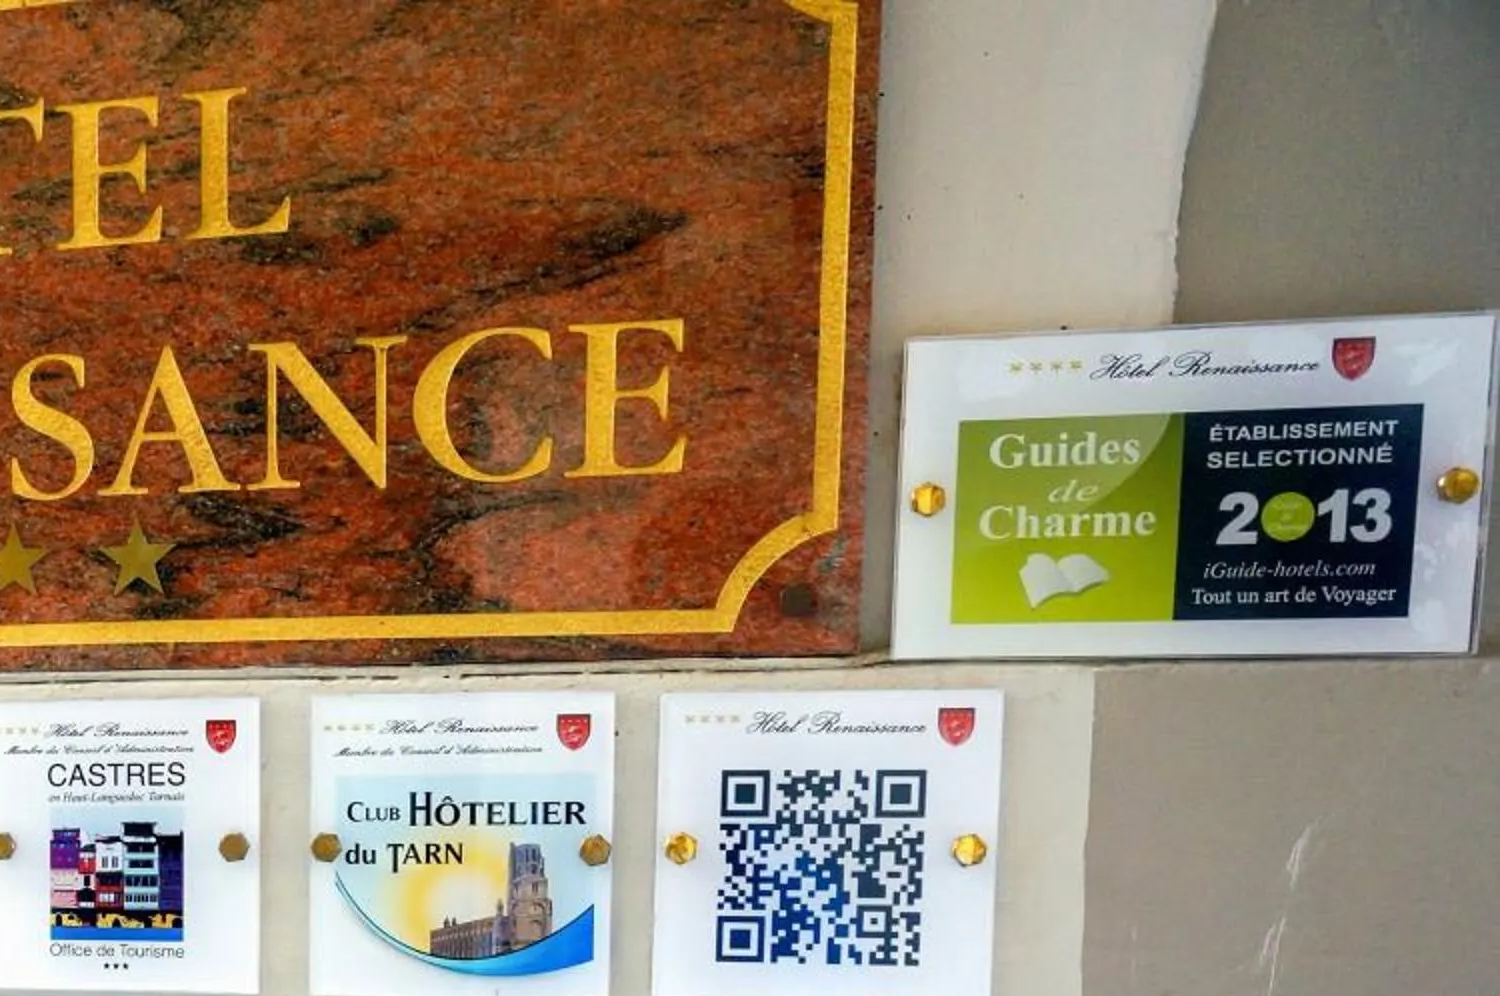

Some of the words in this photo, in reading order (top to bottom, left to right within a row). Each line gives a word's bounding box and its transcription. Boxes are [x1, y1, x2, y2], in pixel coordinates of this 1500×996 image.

[1090, 351, 1167, 381] Hôtel
[1169, 351, 1320, 378] Renaissance
[1209, 420, 1398, 443] ÉTABLISSEMENT
[989, 432, 1142, 470] Guides
[1207, 445, 1393, 469] SELECTIONNÉ
[1047, 479, 1100, 502] de
[978, 504, 1157, 540] Charme
[1203, 560, 1376, 580] iGuide-hotels.com
[1192, 587, 1231, 605] Tout
[1237, 592, 1261, 604] un
[1265, 589, 1293, 604] art
[1297, 587, 1317, 603] de
[1320, 585, 1397, 606] Voyager
[745, 711, 809, 735] Hôtel
[808, 710, 928, 735] Renaissance
[48, 762, 186, 787] CASTRES
[409, 792, 586, 826] HÔTELIER
[345, 843, 377, 865] du
[387, 843, 464, 874] TARN
[49, 943, 92, 958] Office
[96, 944, 115, 957] de
[119, 943, 185, 959] Tourisme
